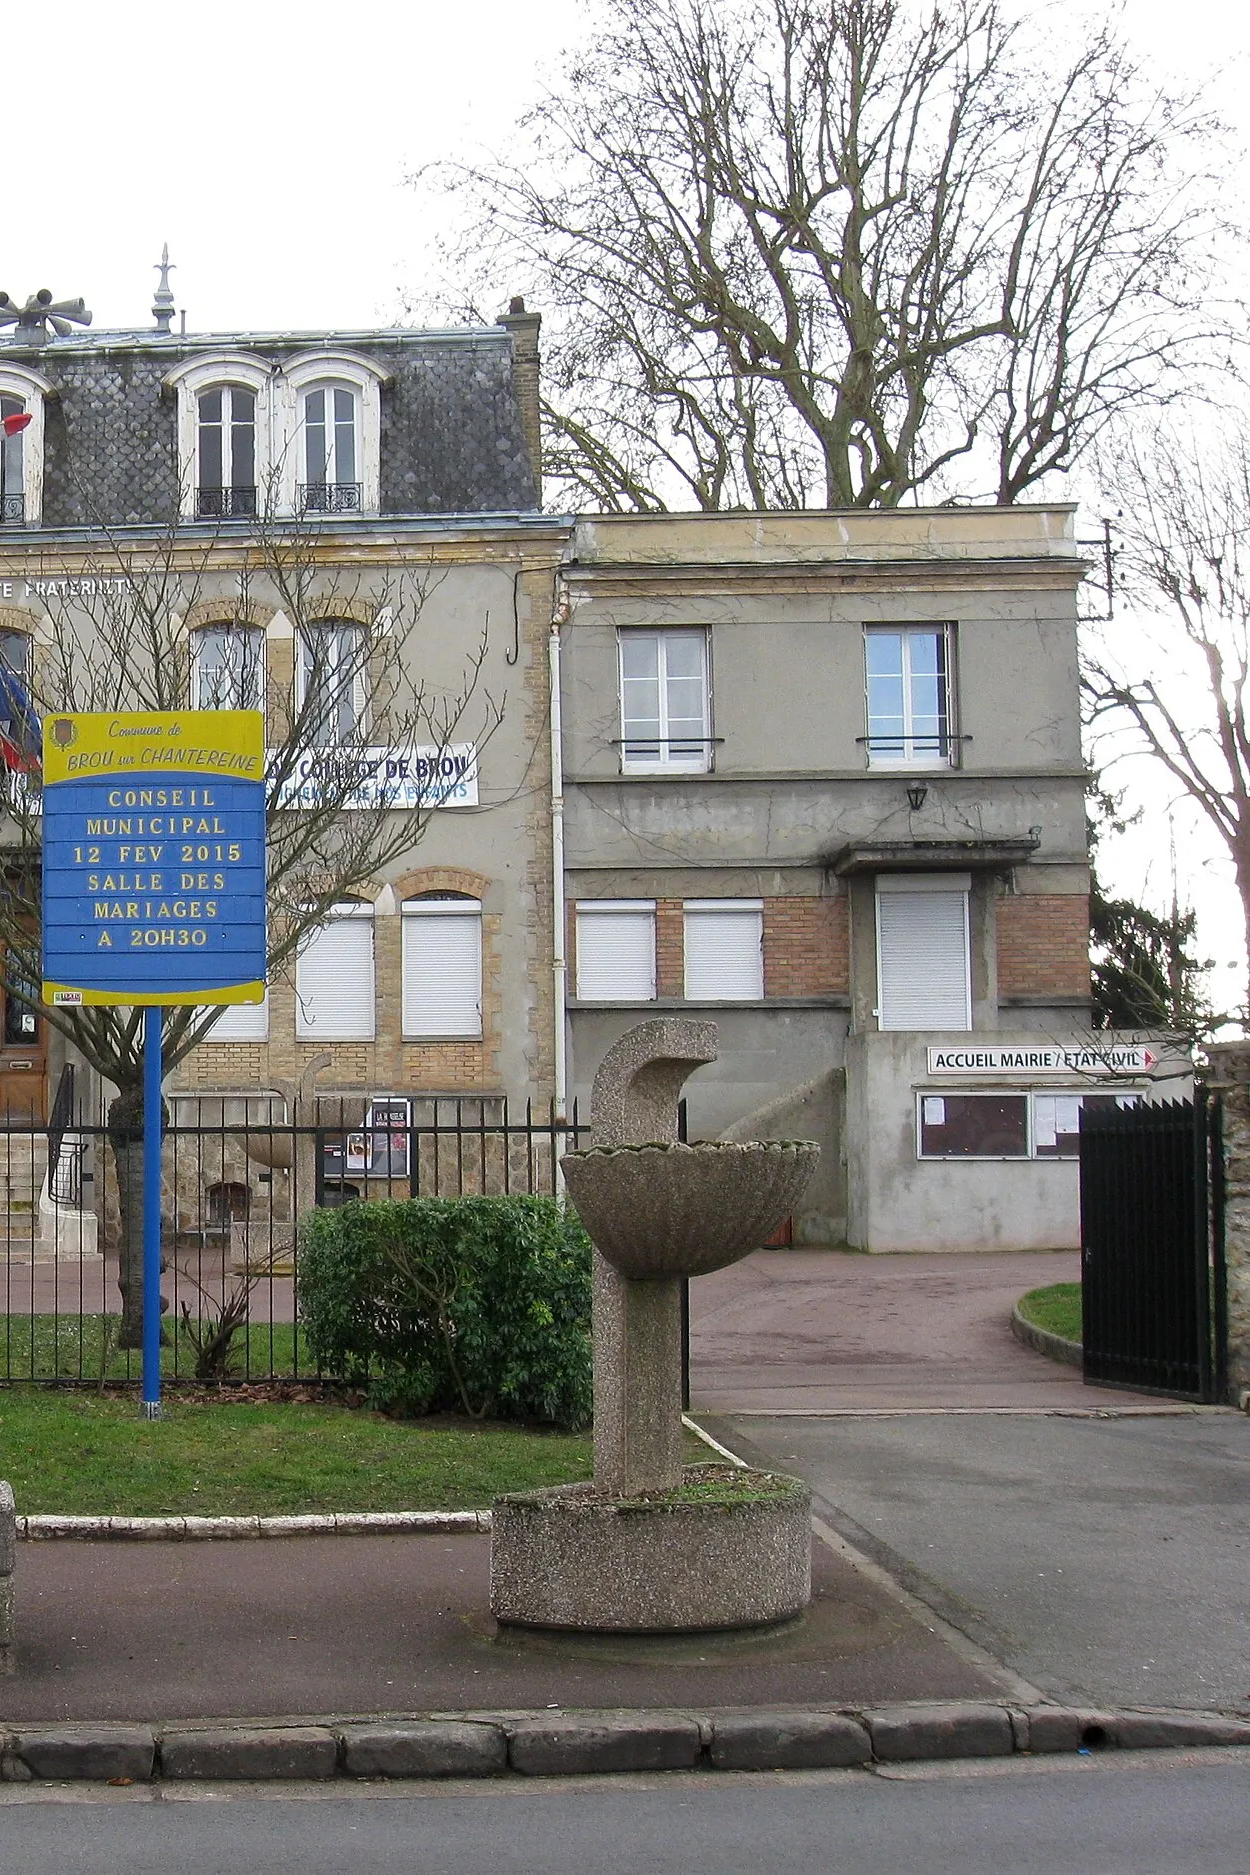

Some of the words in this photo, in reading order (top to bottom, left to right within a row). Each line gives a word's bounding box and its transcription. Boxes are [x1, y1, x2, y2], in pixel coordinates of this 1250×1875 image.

[108, 720, 163, 738] Commune
[167, 721, 182, 737] de
[67, 750, 114, 771] BROU
[118, 754, 136, 766] sur
[140, 748, 258, 771] CHANTEREINE
[386, 759, 410, 779] DE
[417, 756, 467, 777] BROU
[108, 790, 215, 807] CONSEIL
[86, 818, 226, 835] MUNICIPAL
[74, 846, 100, 863] 12
[119, 846, 163, 863] FEV
[181, 844, 242, 862] 2015
[88, 874, 163, 891] SALLE
[181, 873, 225, 890] DES
[94, 901, 218, 918] MARIAGES
[98, 931, 112, 946] A
[130, 929, 207, 946] 20H30
[935, 1053, 997, 1068] ACCUEIL
[1000, 1053, 1052, 1067] MAIRIE
[1065, 1052, 1097, 1066] ETAT
